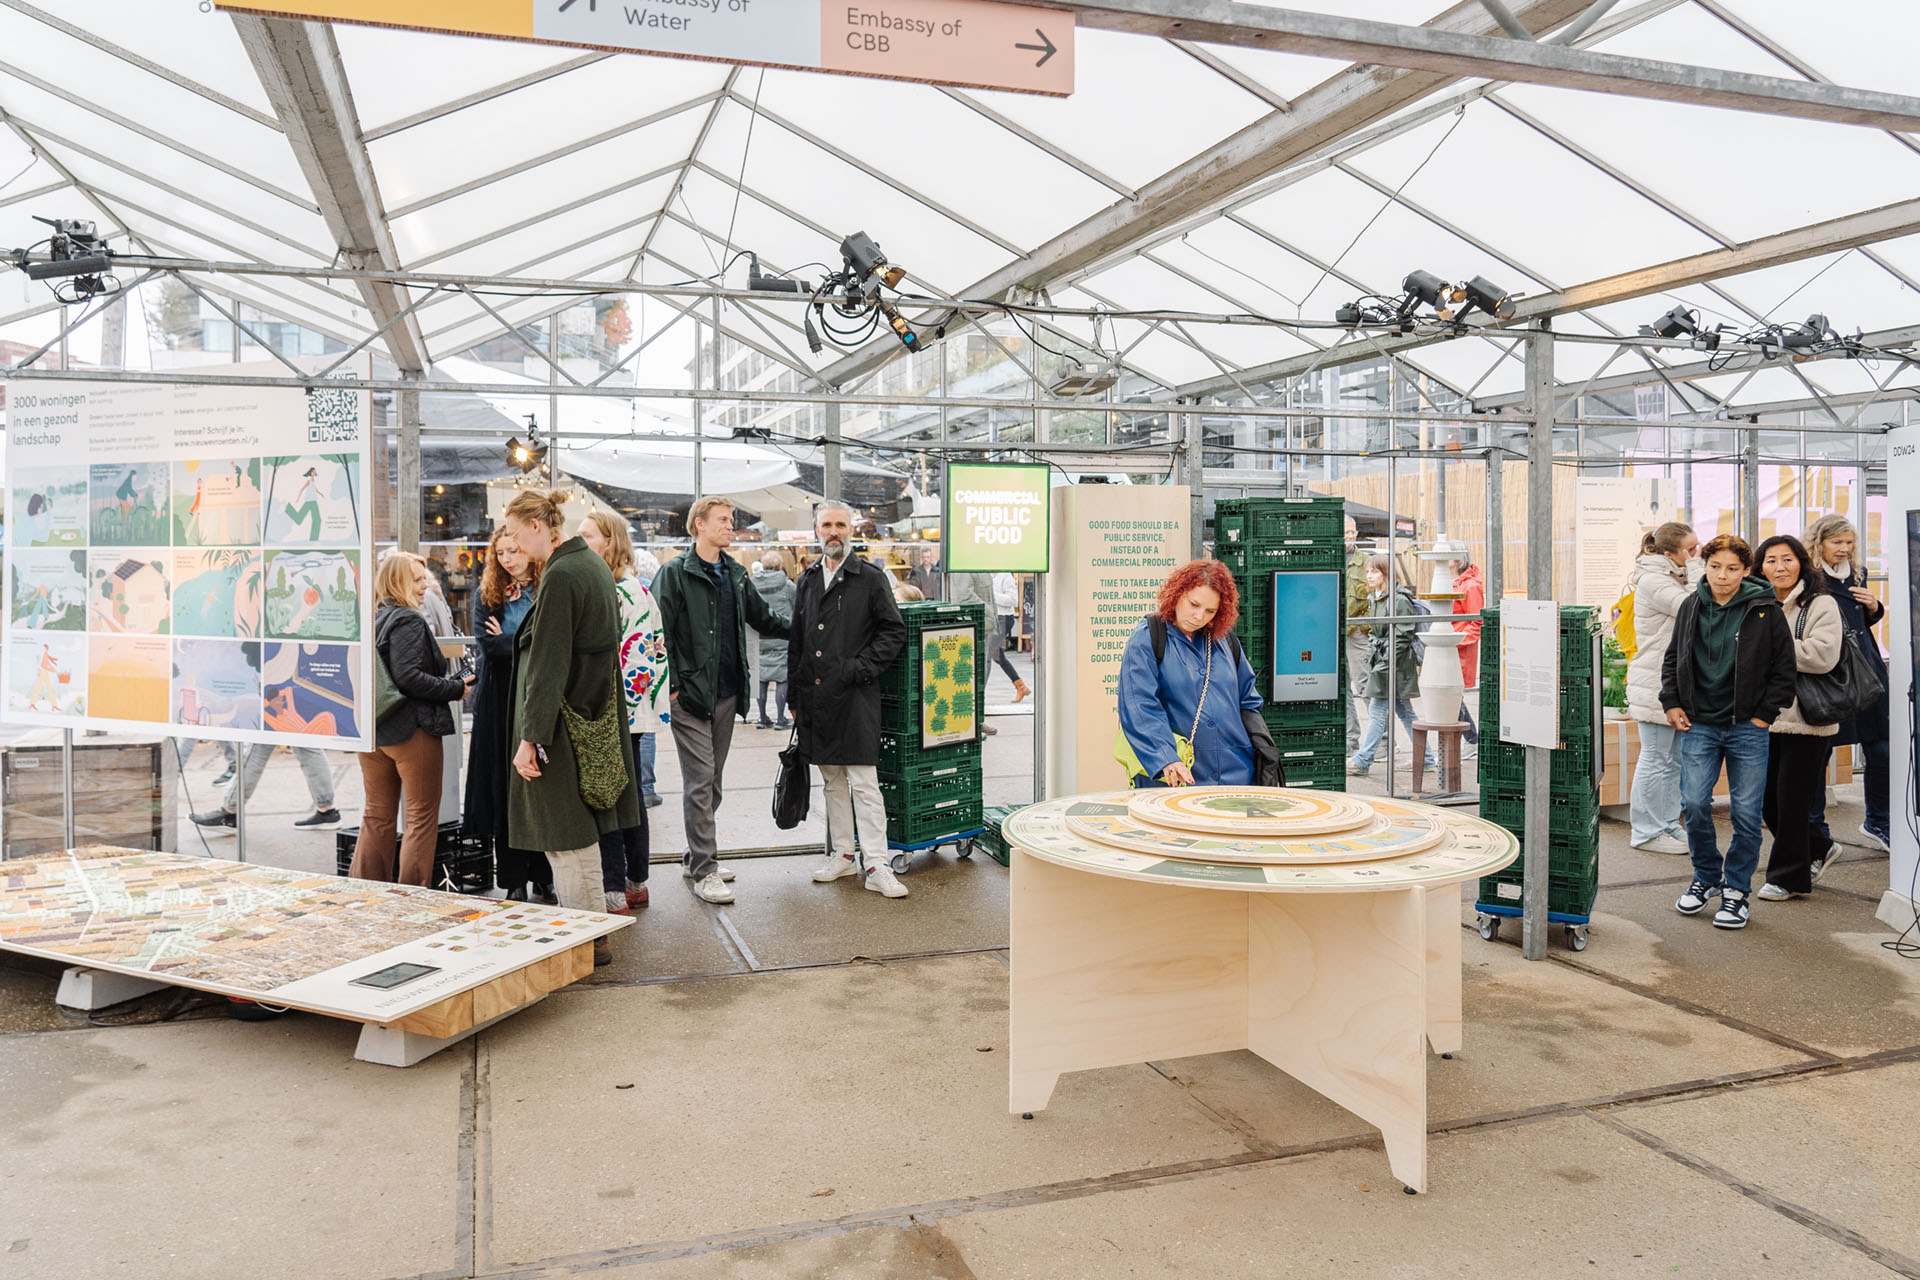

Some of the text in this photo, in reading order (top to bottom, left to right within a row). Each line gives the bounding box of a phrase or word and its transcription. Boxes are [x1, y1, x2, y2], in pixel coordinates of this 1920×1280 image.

[624, 6, 691, 31] Water
[847, 7, 963, 37] Embassy of
[846, 32, 890, 52] CBB
[13, 395, 37, 409] 3000
[40, 393, 86, 409] woningen
[13, 415, 22, 428] in
[24, 417, 41, 427] een
[44, 412, 78, 428] gezond
[13, 432, 61, 446] landschap
[1893, 444, 1916, 457] DDW24
[965, 506, 1031, 526] PUBLIC
[1088, 520, 1179, 530] GOOD FOOD SHOULD BE A
[974, 525, 1022, 545] FOOD
[1103, 533, 1165, 543] PUBLIC SERVICE,
[1110, 545, 1159, 554] INSTEAD OF A
[1091, 558, 1177, 567] COMMERCIAL PRODUCT.
[1100, 578, 1164, 588] TIME TO TAKE BAC
[1092, 591, 1157, 600] POWER. AND SINC
[1097, 603, 1148, 613] GOVERNMENT
[1148, 603, 1156, 612] IS
[1090, 616, 1117, 625] TAKING
[1092, 628, 1133, 638] WE FOUND
[938, 634, 959, 644] PUBLIC
[941, 643, 956, 651] FOOD
[1097, 641, 1124, 650] PUBLIC
[1090, 654, 1122, 663] GOOD FO
[1102, 674, 1120, 683] JOIN
